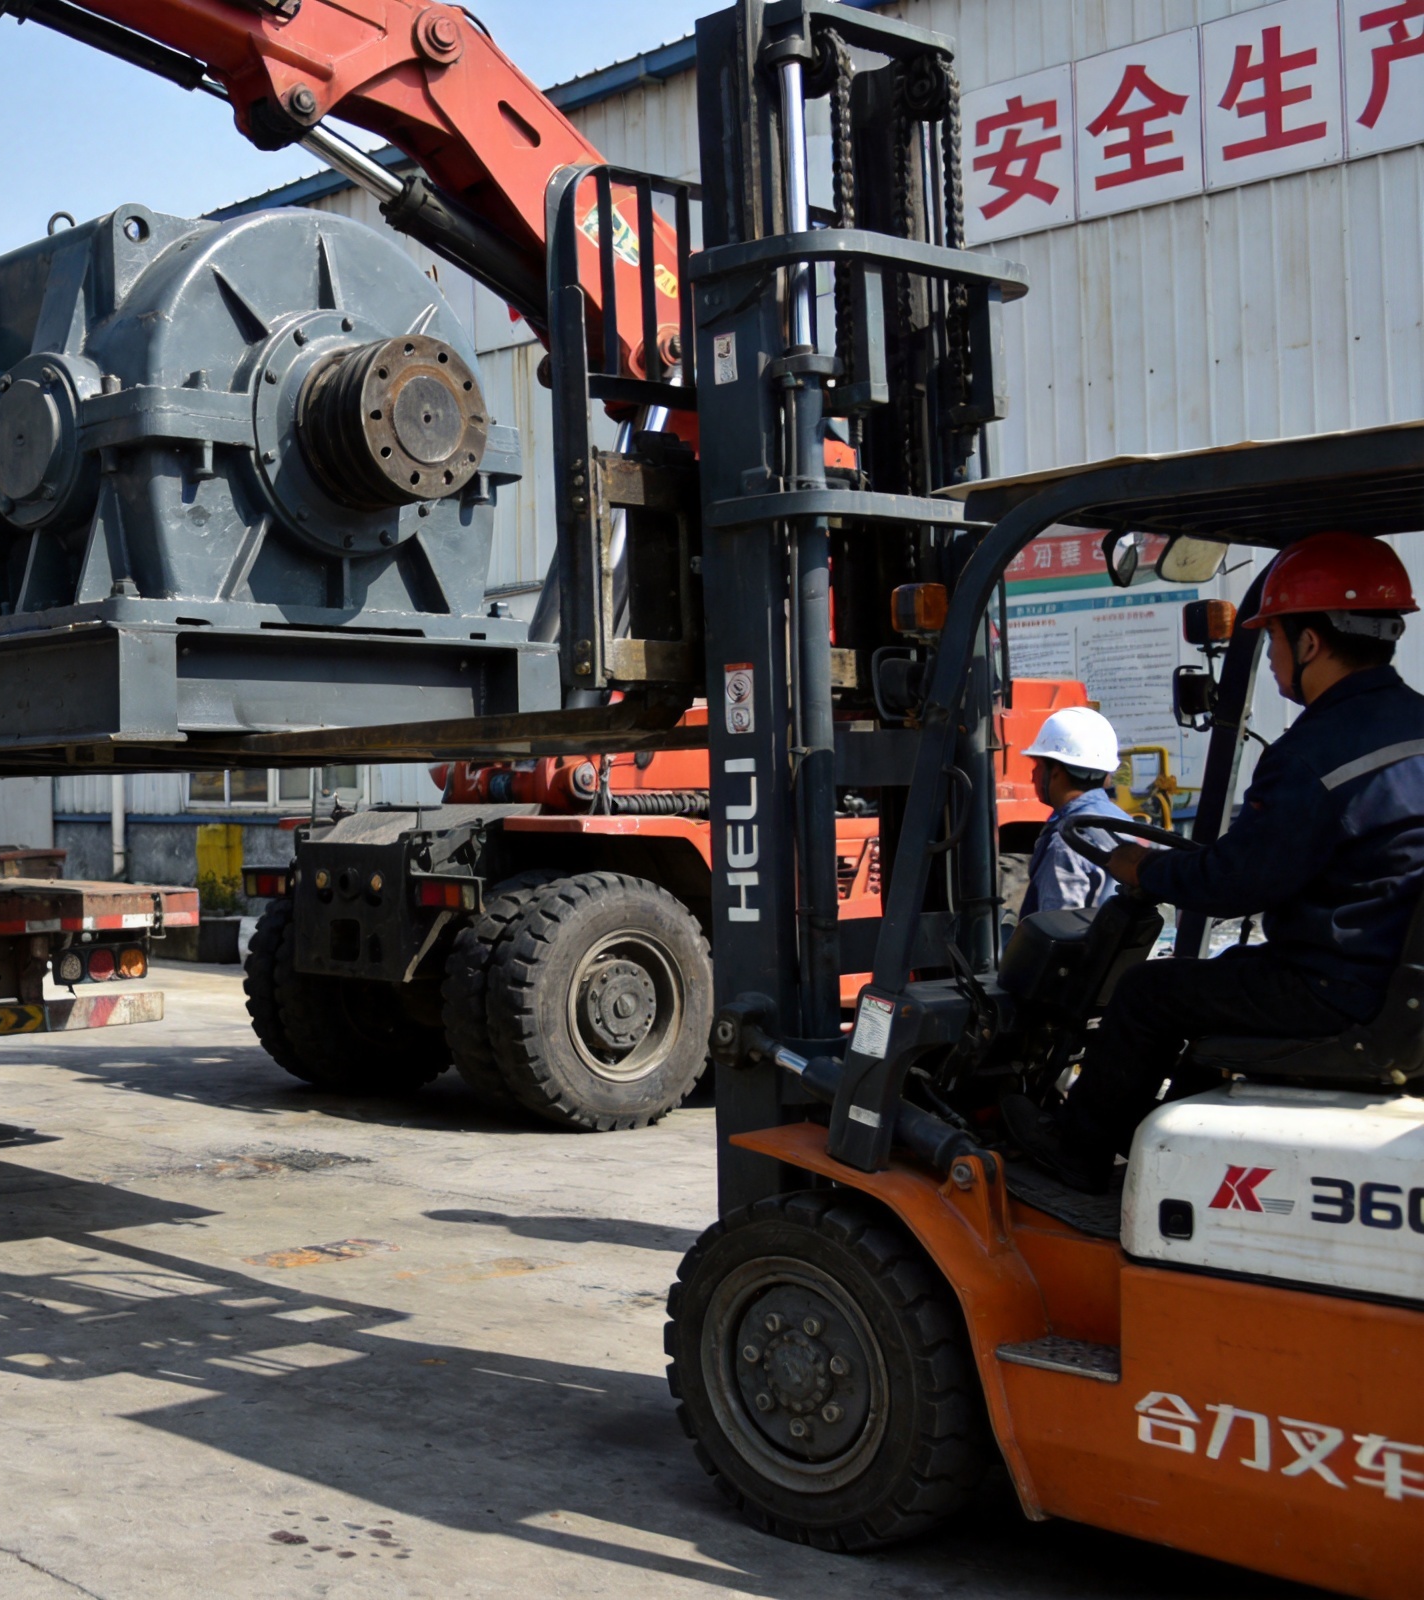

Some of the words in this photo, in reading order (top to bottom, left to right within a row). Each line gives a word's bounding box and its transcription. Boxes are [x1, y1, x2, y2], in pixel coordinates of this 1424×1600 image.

[724, 758, 761, 923] HELI
[1134, 1390, 1424, 1502] 合力叉车
